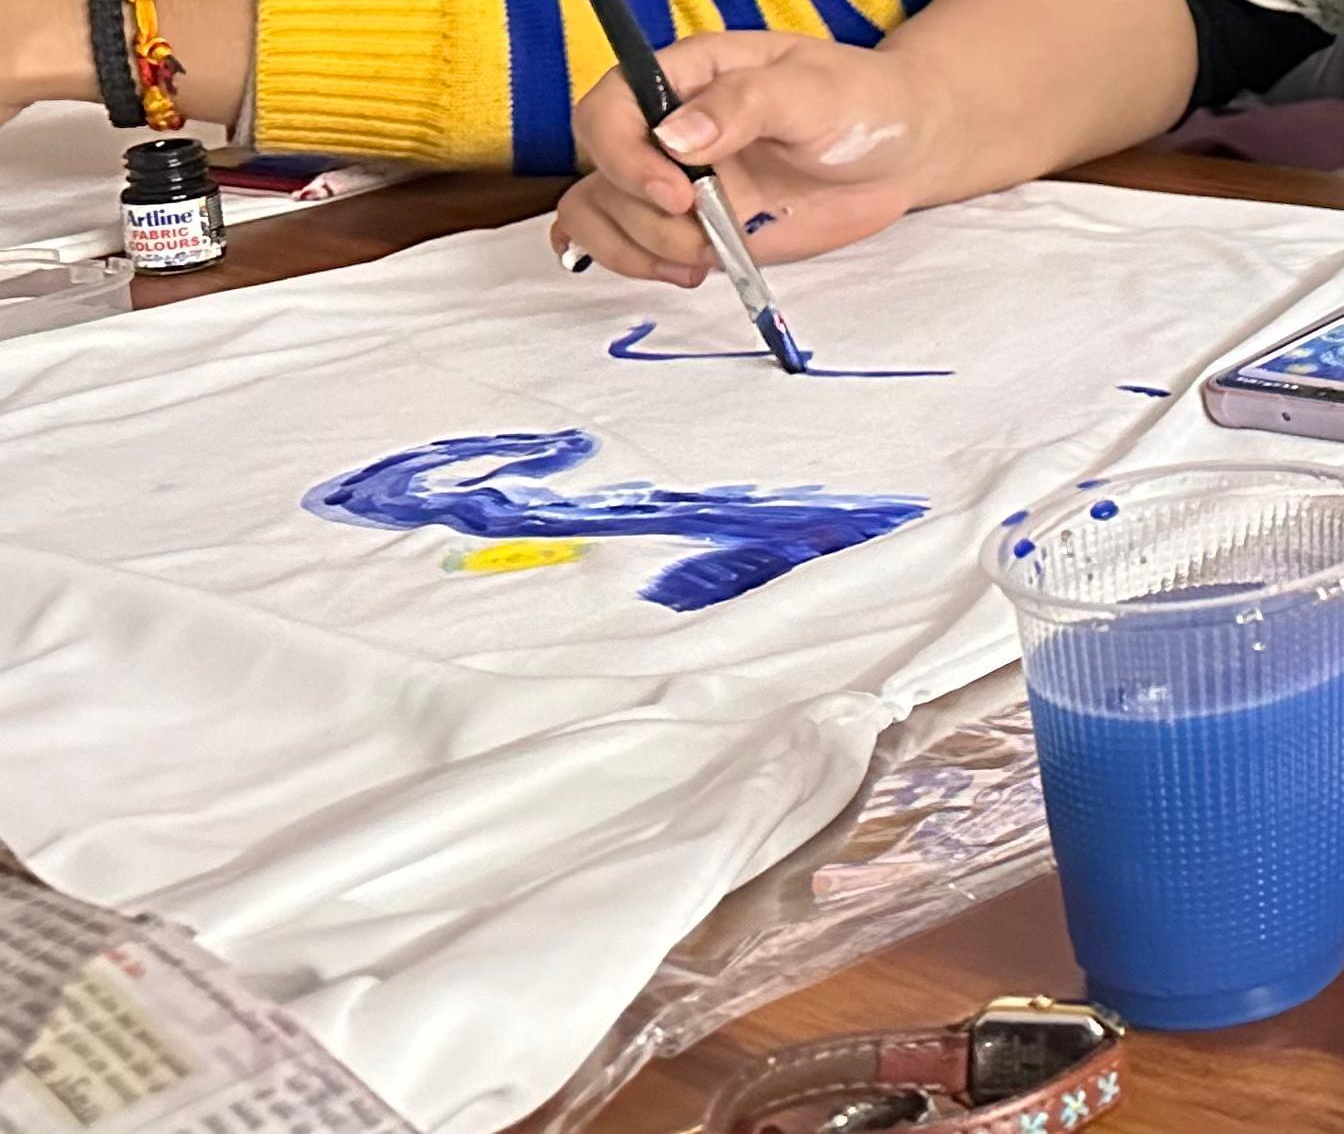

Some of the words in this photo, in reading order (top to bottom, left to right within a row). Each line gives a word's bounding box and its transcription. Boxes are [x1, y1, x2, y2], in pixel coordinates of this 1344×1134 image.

[127, 209, 193, 227] Artline
[132, 227, 189, 240] FABRIC
[129, 236, 200, 252] COLOURS
